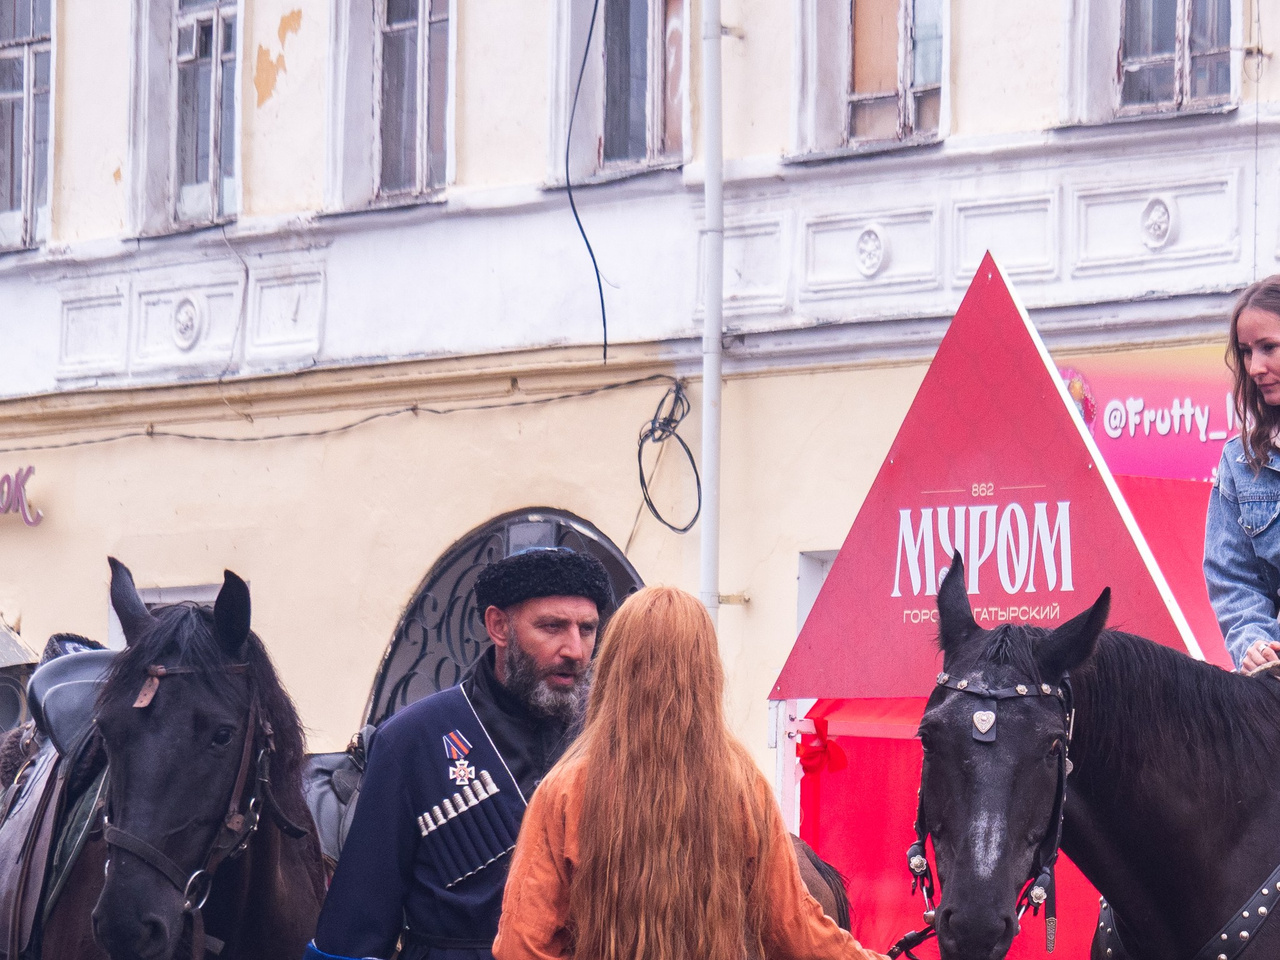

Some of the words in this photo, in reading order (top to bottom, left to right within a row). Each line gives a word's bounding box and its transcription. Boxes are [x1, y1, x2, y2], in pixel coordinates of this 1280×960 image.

[971, 483, 995, 497] 862
[890, 500, 1075, 598] МУРОМ
[972, 602, 1060, 622] ГАТЫРСКИЙ
